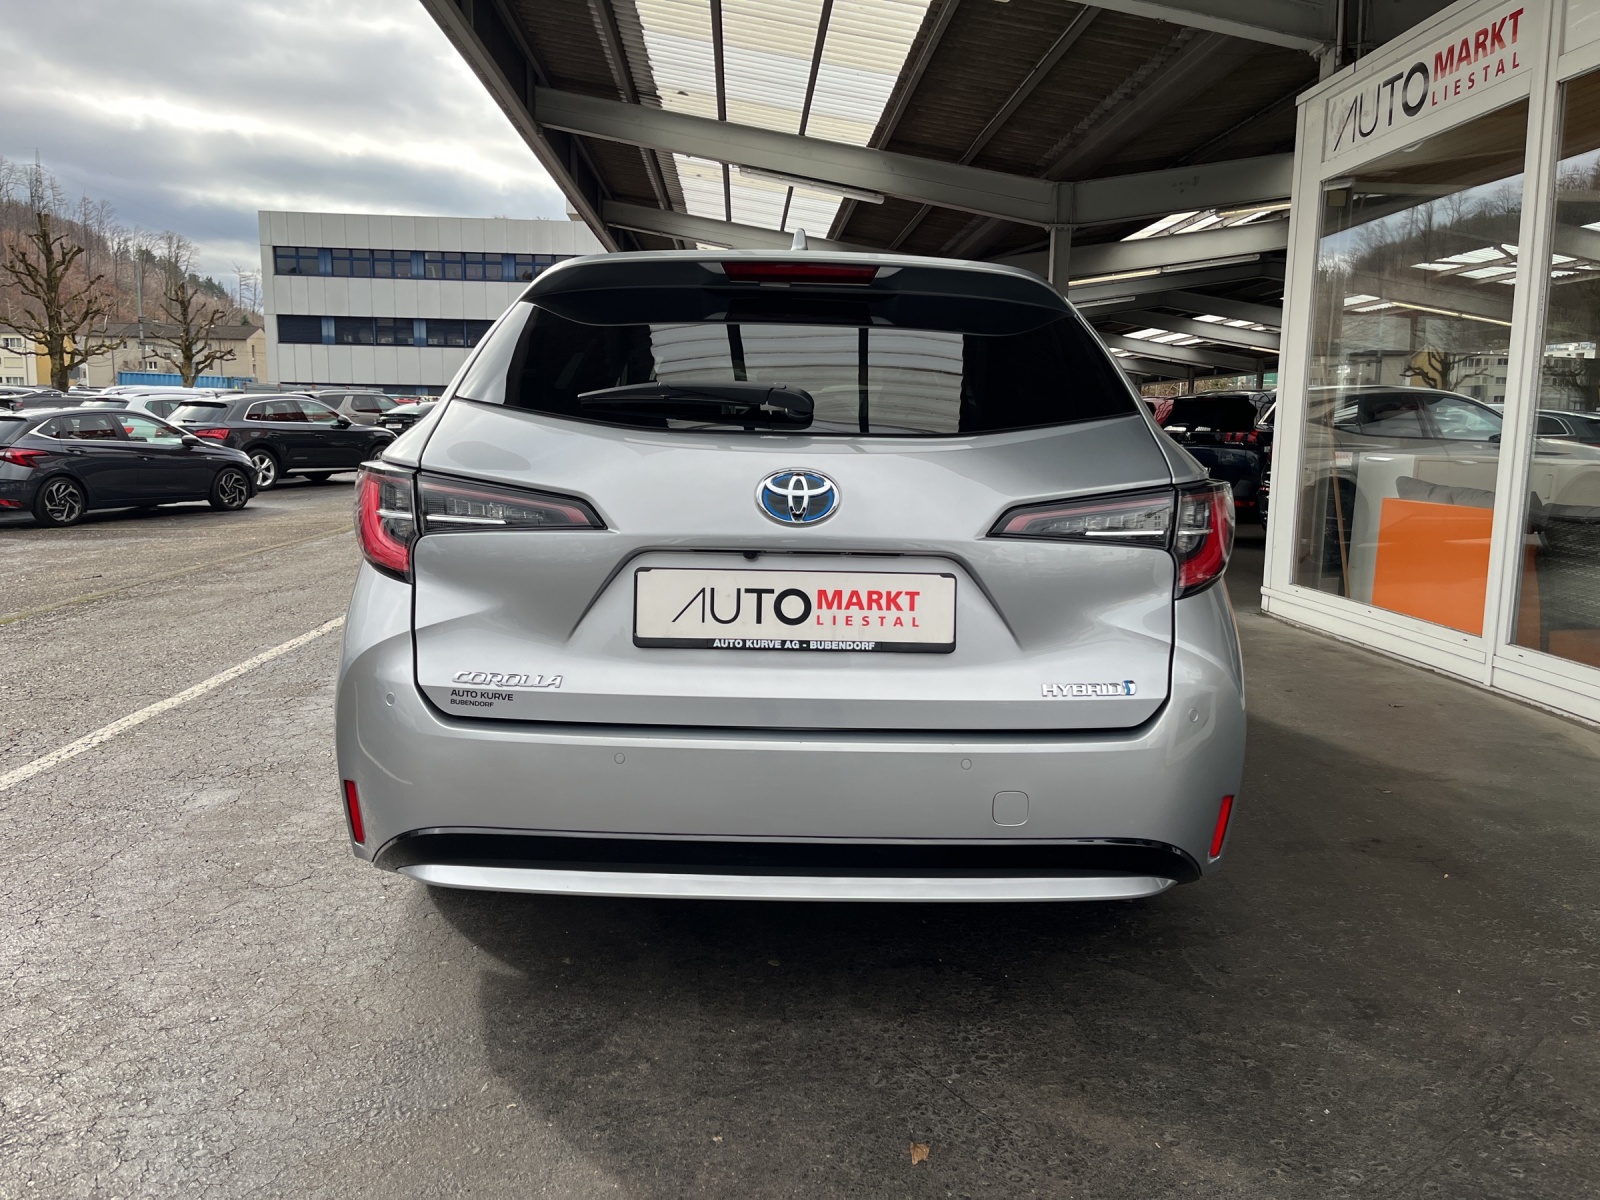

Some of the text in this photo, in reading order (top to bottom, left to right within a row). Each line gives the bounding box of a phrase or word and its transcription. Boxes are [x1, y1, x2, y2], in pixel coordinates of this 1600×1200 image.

[1334, 7, 1525, 151] AUTO MARKT
[1431, 52, 1520, 107] LIESTAL
[671, 587, 921, 626] AUTO MARKT
[816, 615, 920, 628] LIESTAL
[713, 638, 743, 649] AUTO
[745, 639, 782, 649] KURVE
[783, 639, 800, 650] AG
[809, 640, 876, 651] BUBENDORF
[452, 670, 564, 689] COROLLA
[450, 689, 514, 702] AUTO KURVE
[1041, 682, 1122, 698] HYBRID
[450, 699, 495, 708] BUBENDORF
